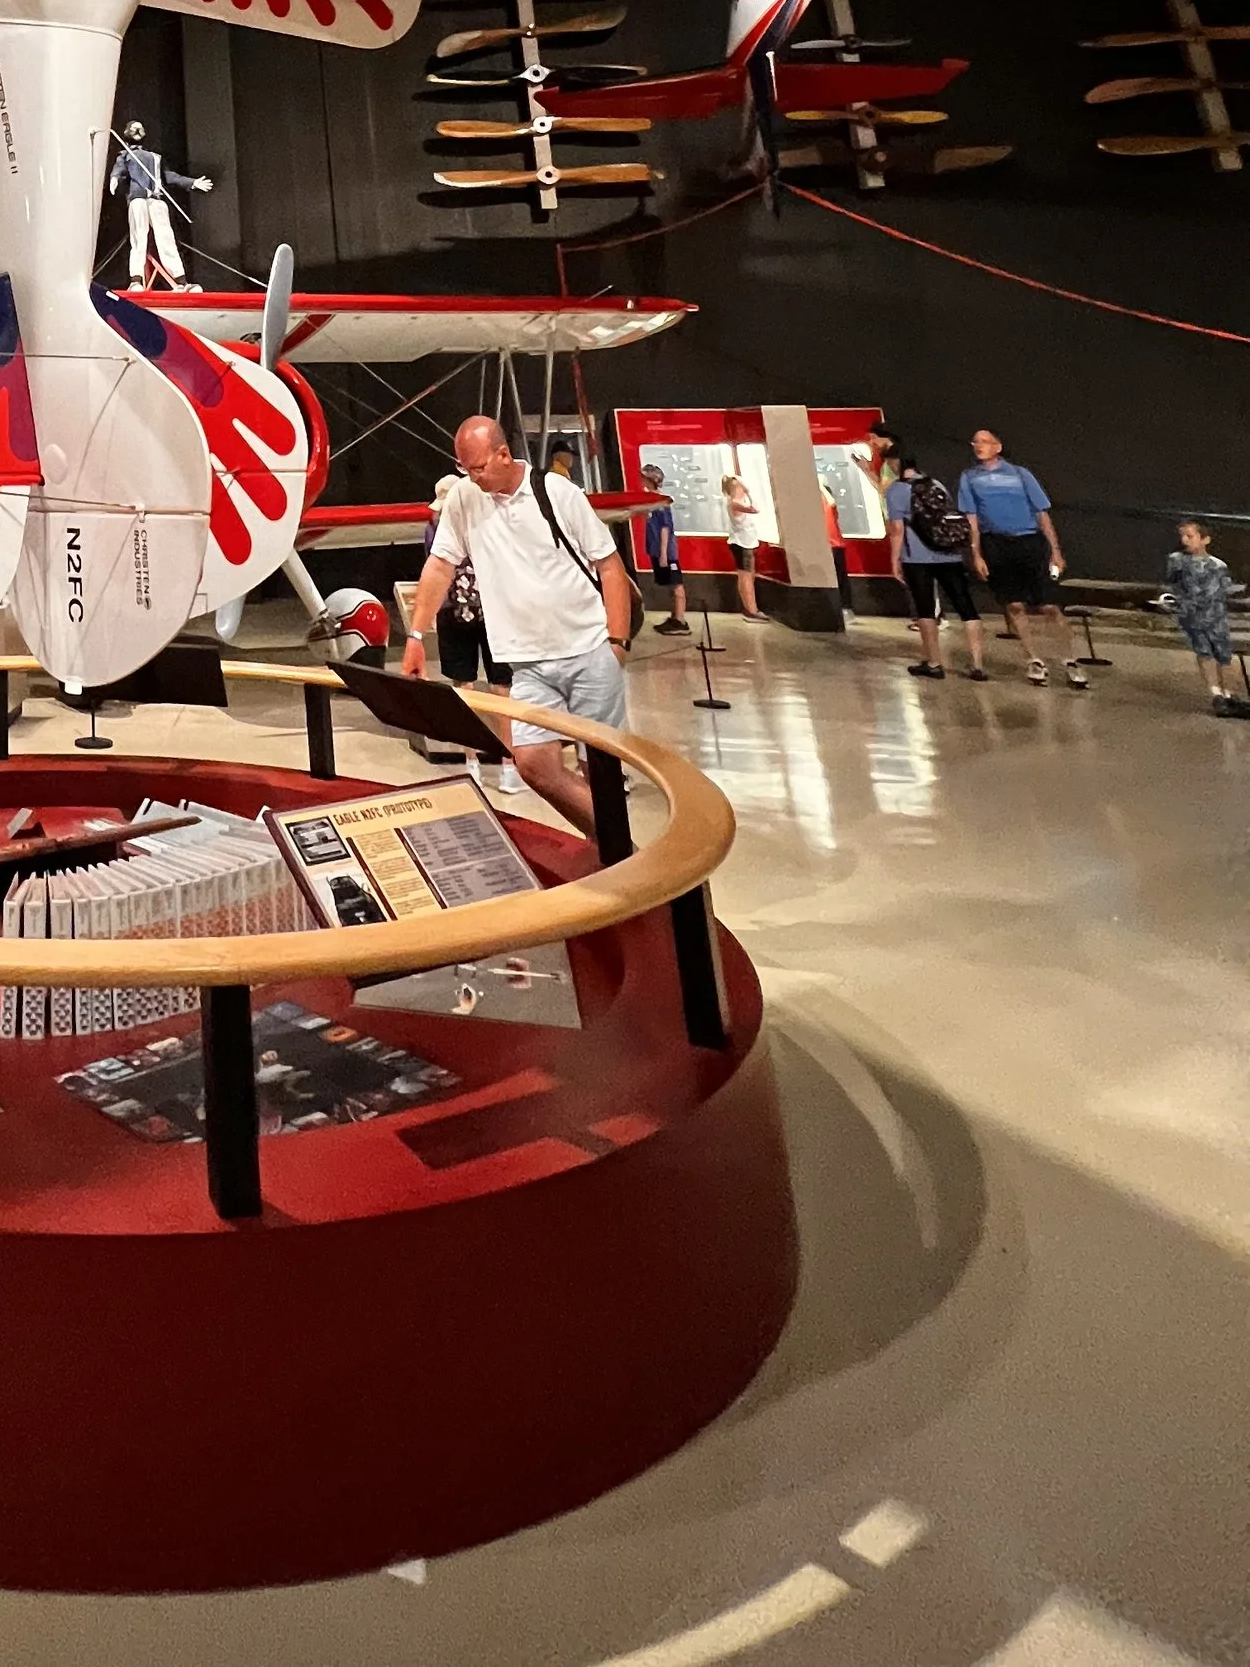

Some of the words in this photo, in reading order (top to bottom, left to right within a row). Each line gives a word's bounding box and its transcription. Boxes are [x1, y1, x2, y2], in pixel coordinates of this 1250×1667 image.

[1, 112, 16, 162] EAGLE
[66, 527, 84, 623] N2FC
[133, 529, 143, 606] INDUSTRIES
[141, 529, 150, 594] CHRISTEN
[332, 809, 362, 826] EAGLE
[359, 806, 384, 821] N2FC
